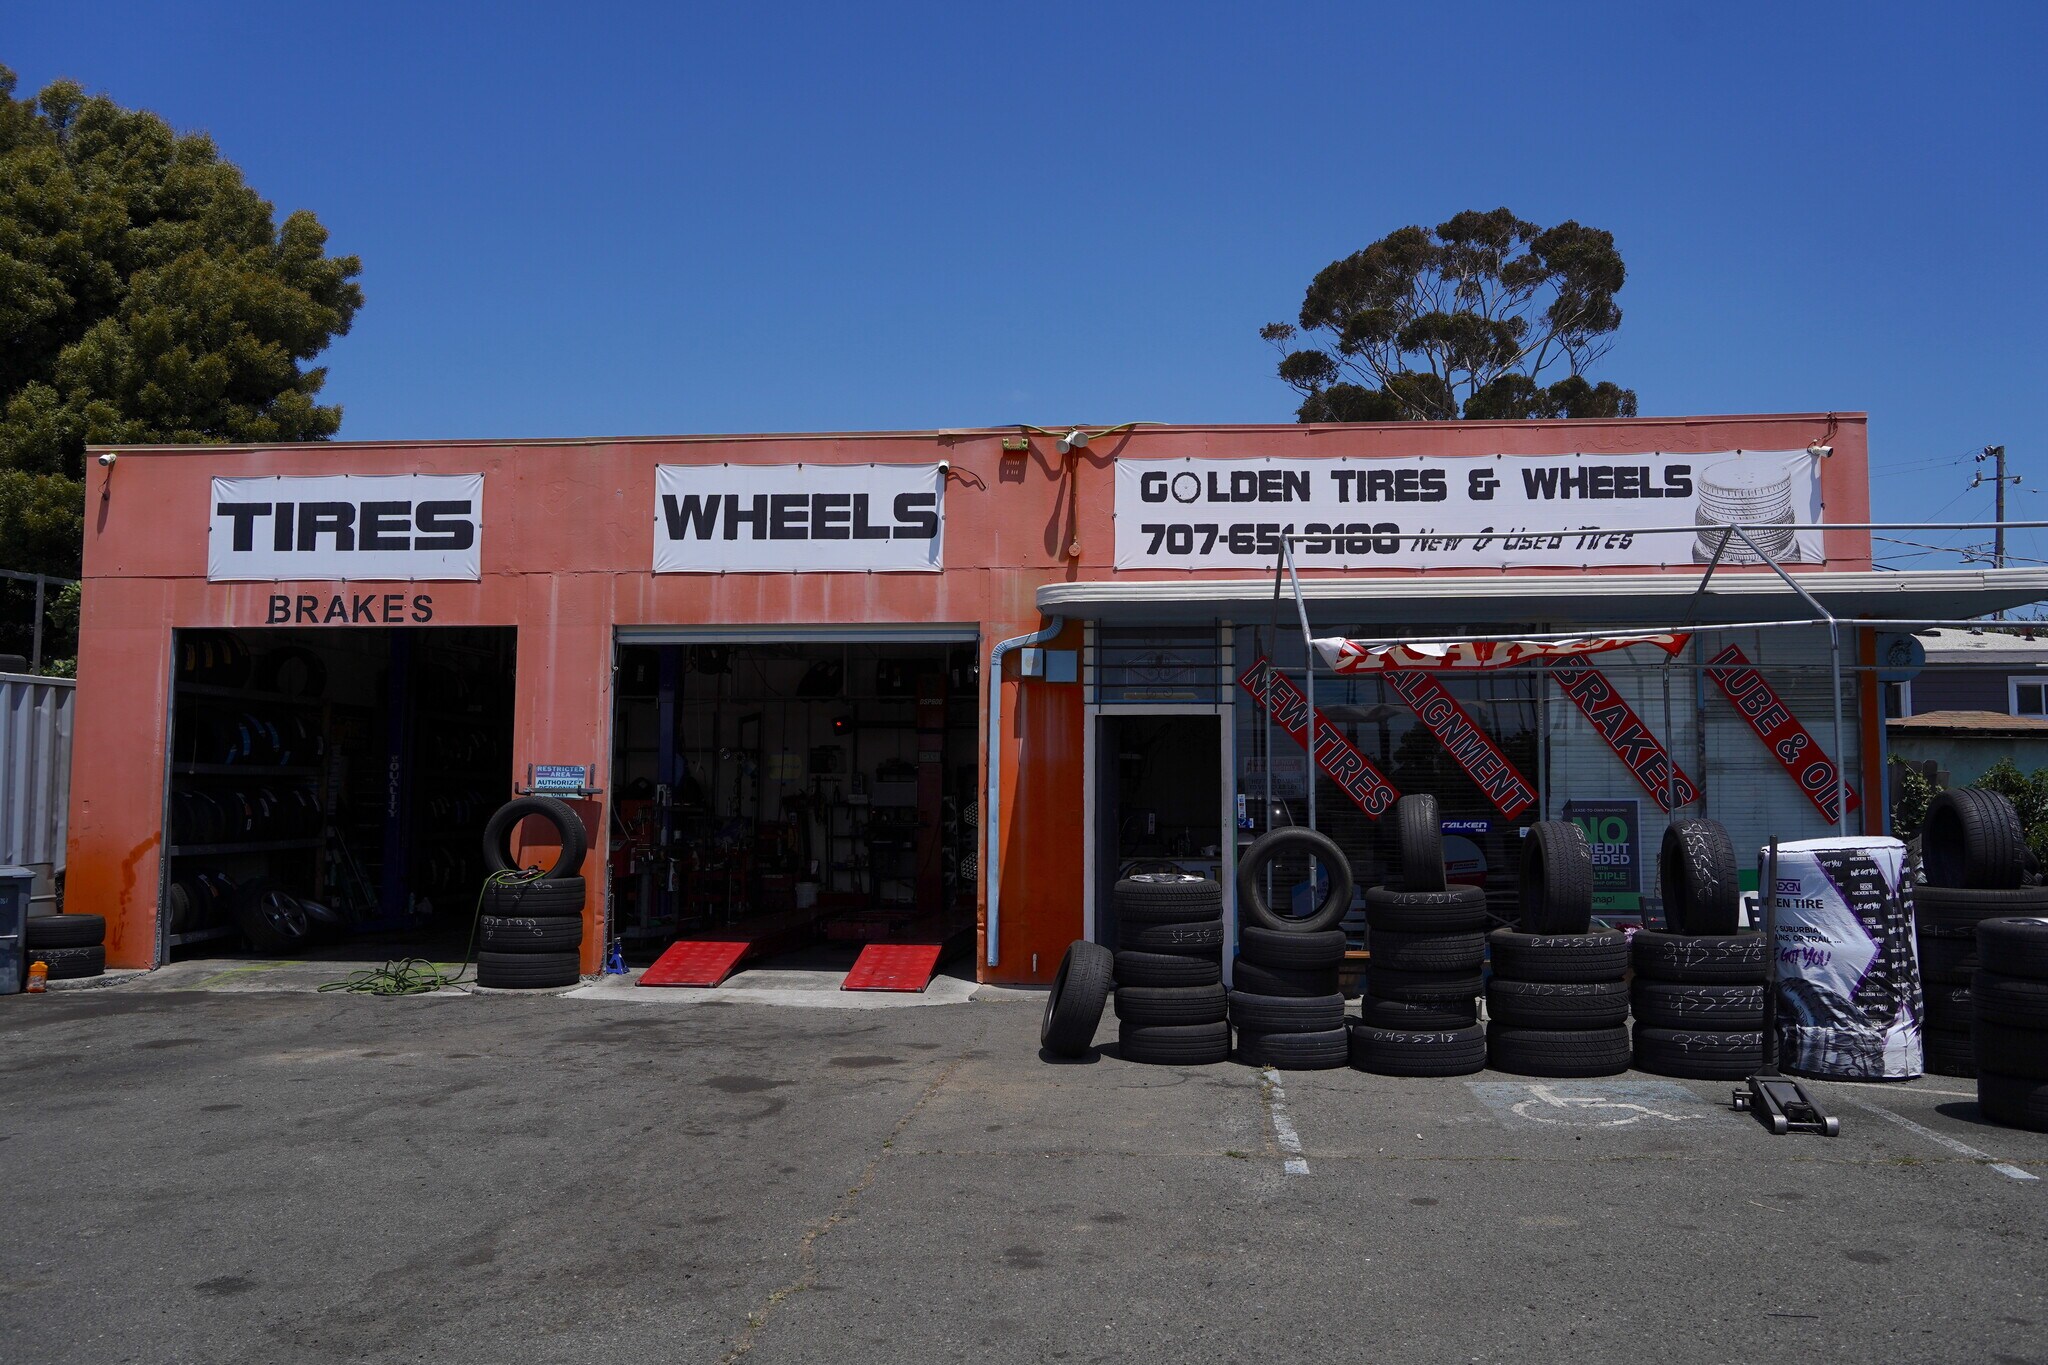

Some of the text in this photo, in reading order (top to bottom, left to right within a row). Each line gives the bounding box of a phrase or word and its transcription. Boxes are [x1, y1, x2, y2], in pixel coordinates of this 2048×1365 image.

[1140, 465, 1693, 504] GOLDEN TIRES & WHEELS
[216, 500, 475, 552] TIRES
[662, 493, 938, 541] WHEELS
[1142, 522, 1400, 555] 707-651-9180
[266, 595, 433, 624] BRAKES
[1242, 659, 1318, 733] NEW
[1313, 723, 1394, 815] TIRES
[1384, 671, 1534, 813] ALIGNMENT
[1549, 655, 1693, 811] BRAKES
[1710, 648, 1789, 737] LUBE
[1776, 733, 1808, 764] &
[1801, 761, 1852, 822] OIL
[1572, 816, 1628, 844] NO
[1588, 843, 1630, 854] REDIT
[1592, 854, 1630, 864] EDED
[1776, 882, 1801, 892] EXEN
[1762, 897, 1824, 909] NEN TIRE
[1780, 926, 1821, 934] SUBURBIA,
[1781, 947, 1802, 964] GOT
